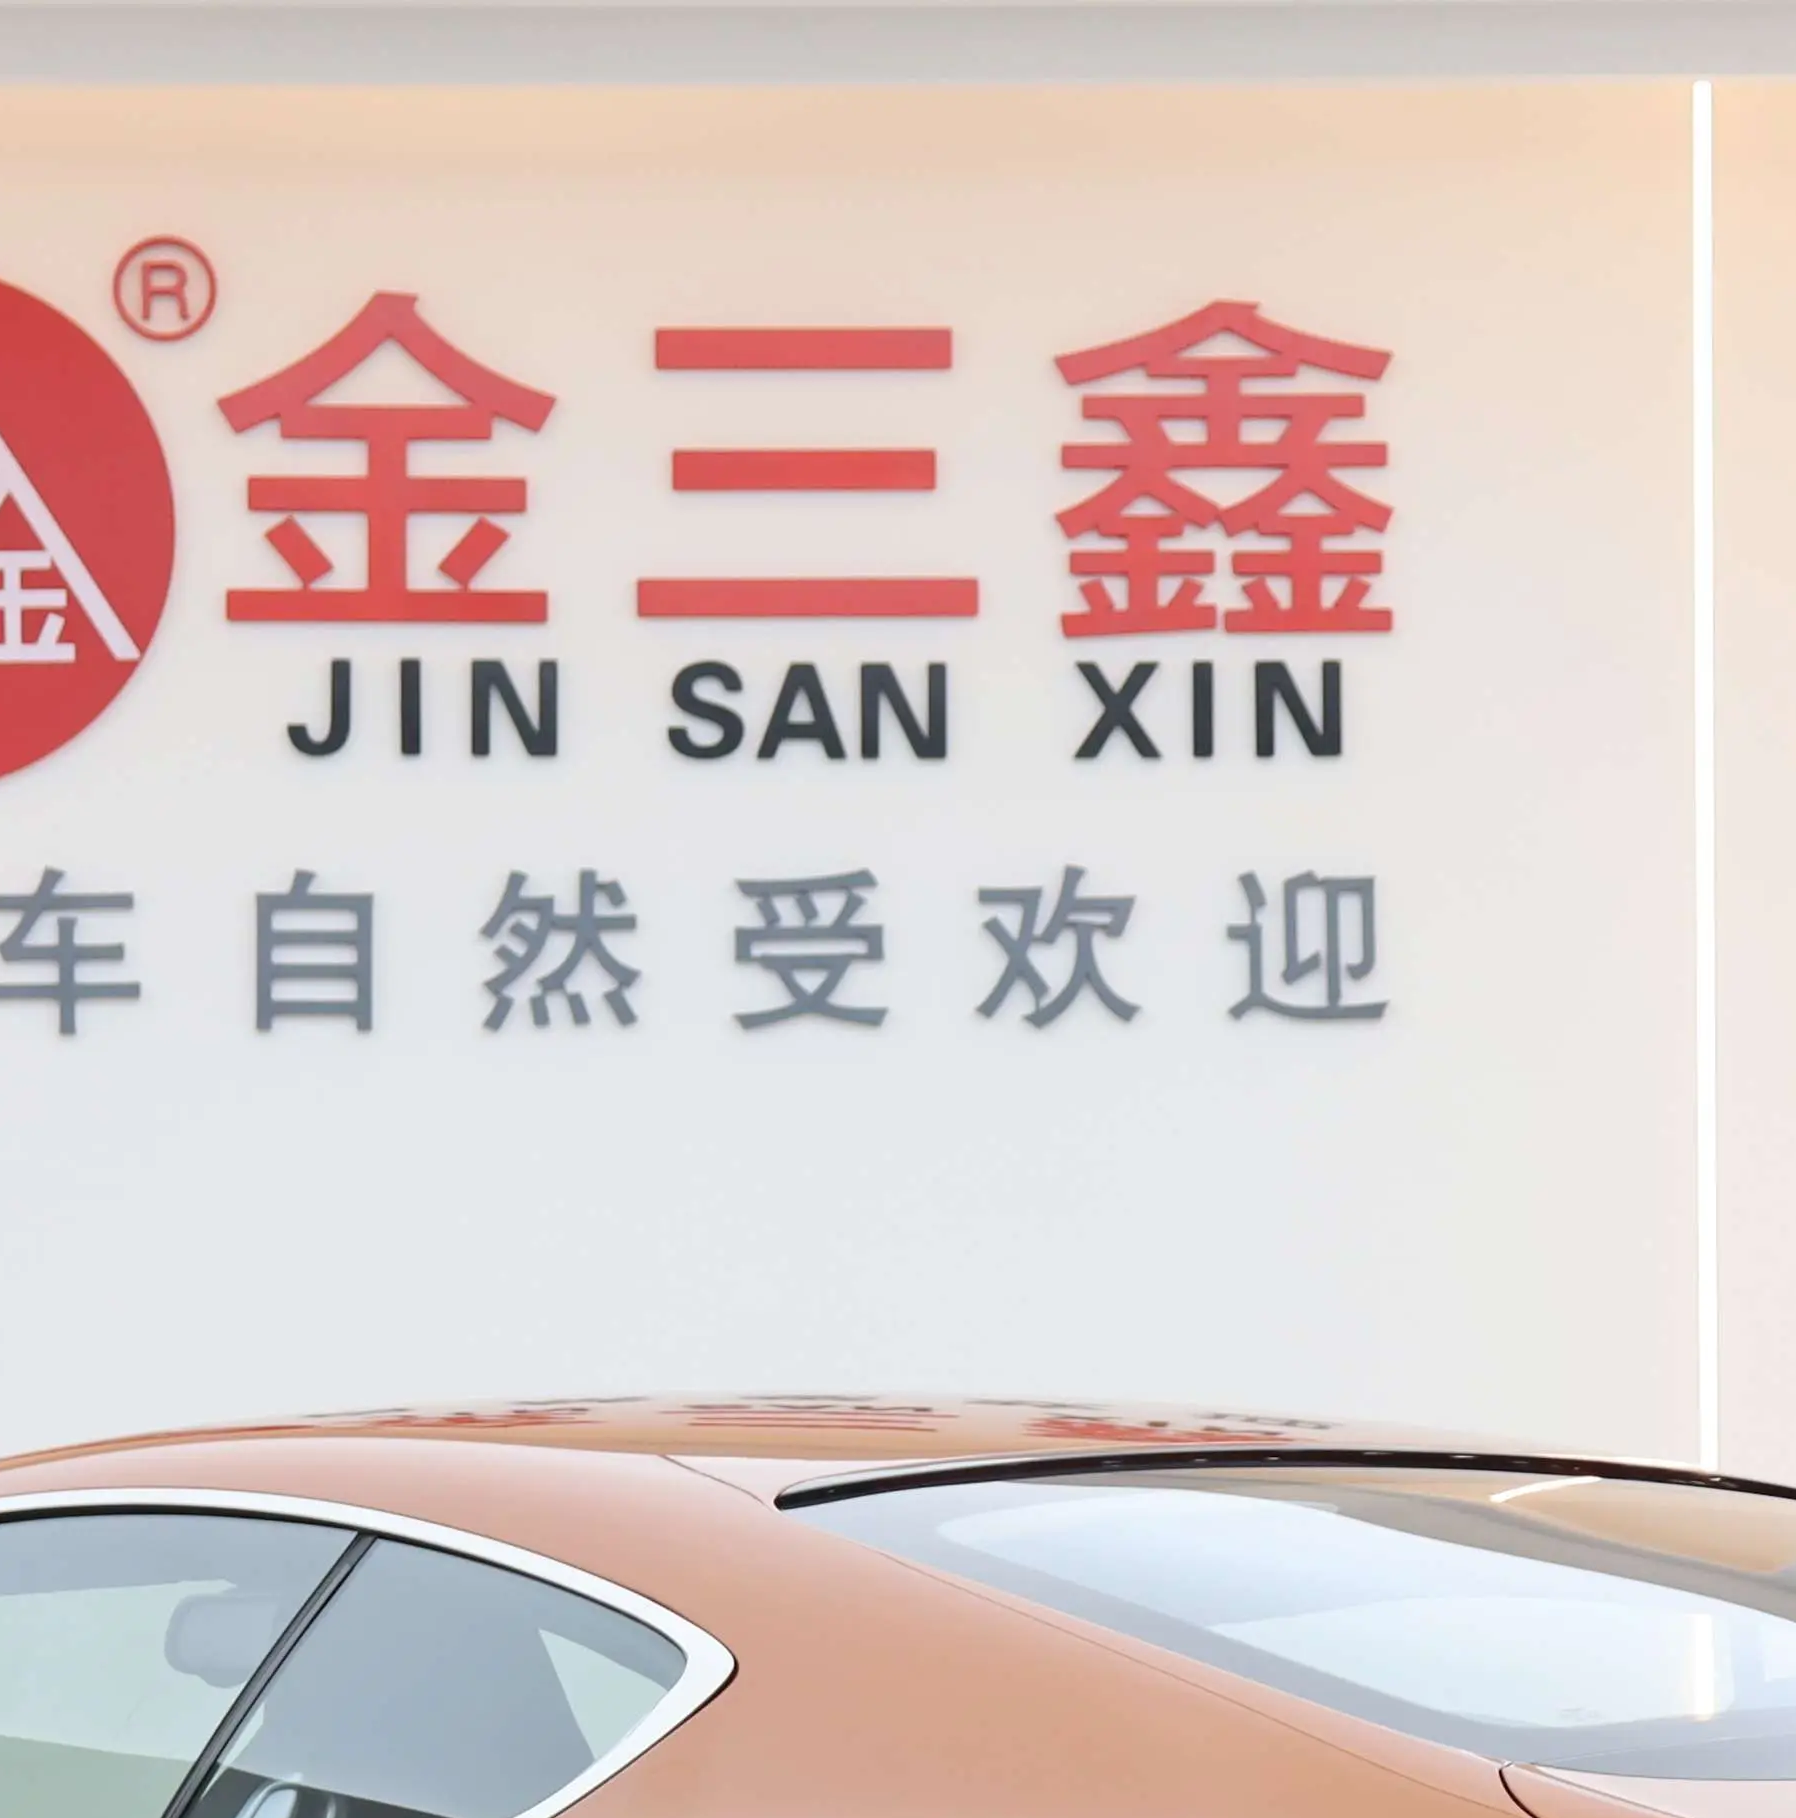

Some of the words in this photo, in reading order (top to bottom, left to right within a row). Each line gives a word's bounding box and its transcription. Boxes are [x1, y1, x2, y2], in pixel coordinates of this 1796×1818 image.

[215, 289, 1394, 638] 金三鑫
[287, 658, 559, 758] JIN
[666, 660, 948, 761] SAN
[1074, 660, 1344, 760] XIN
